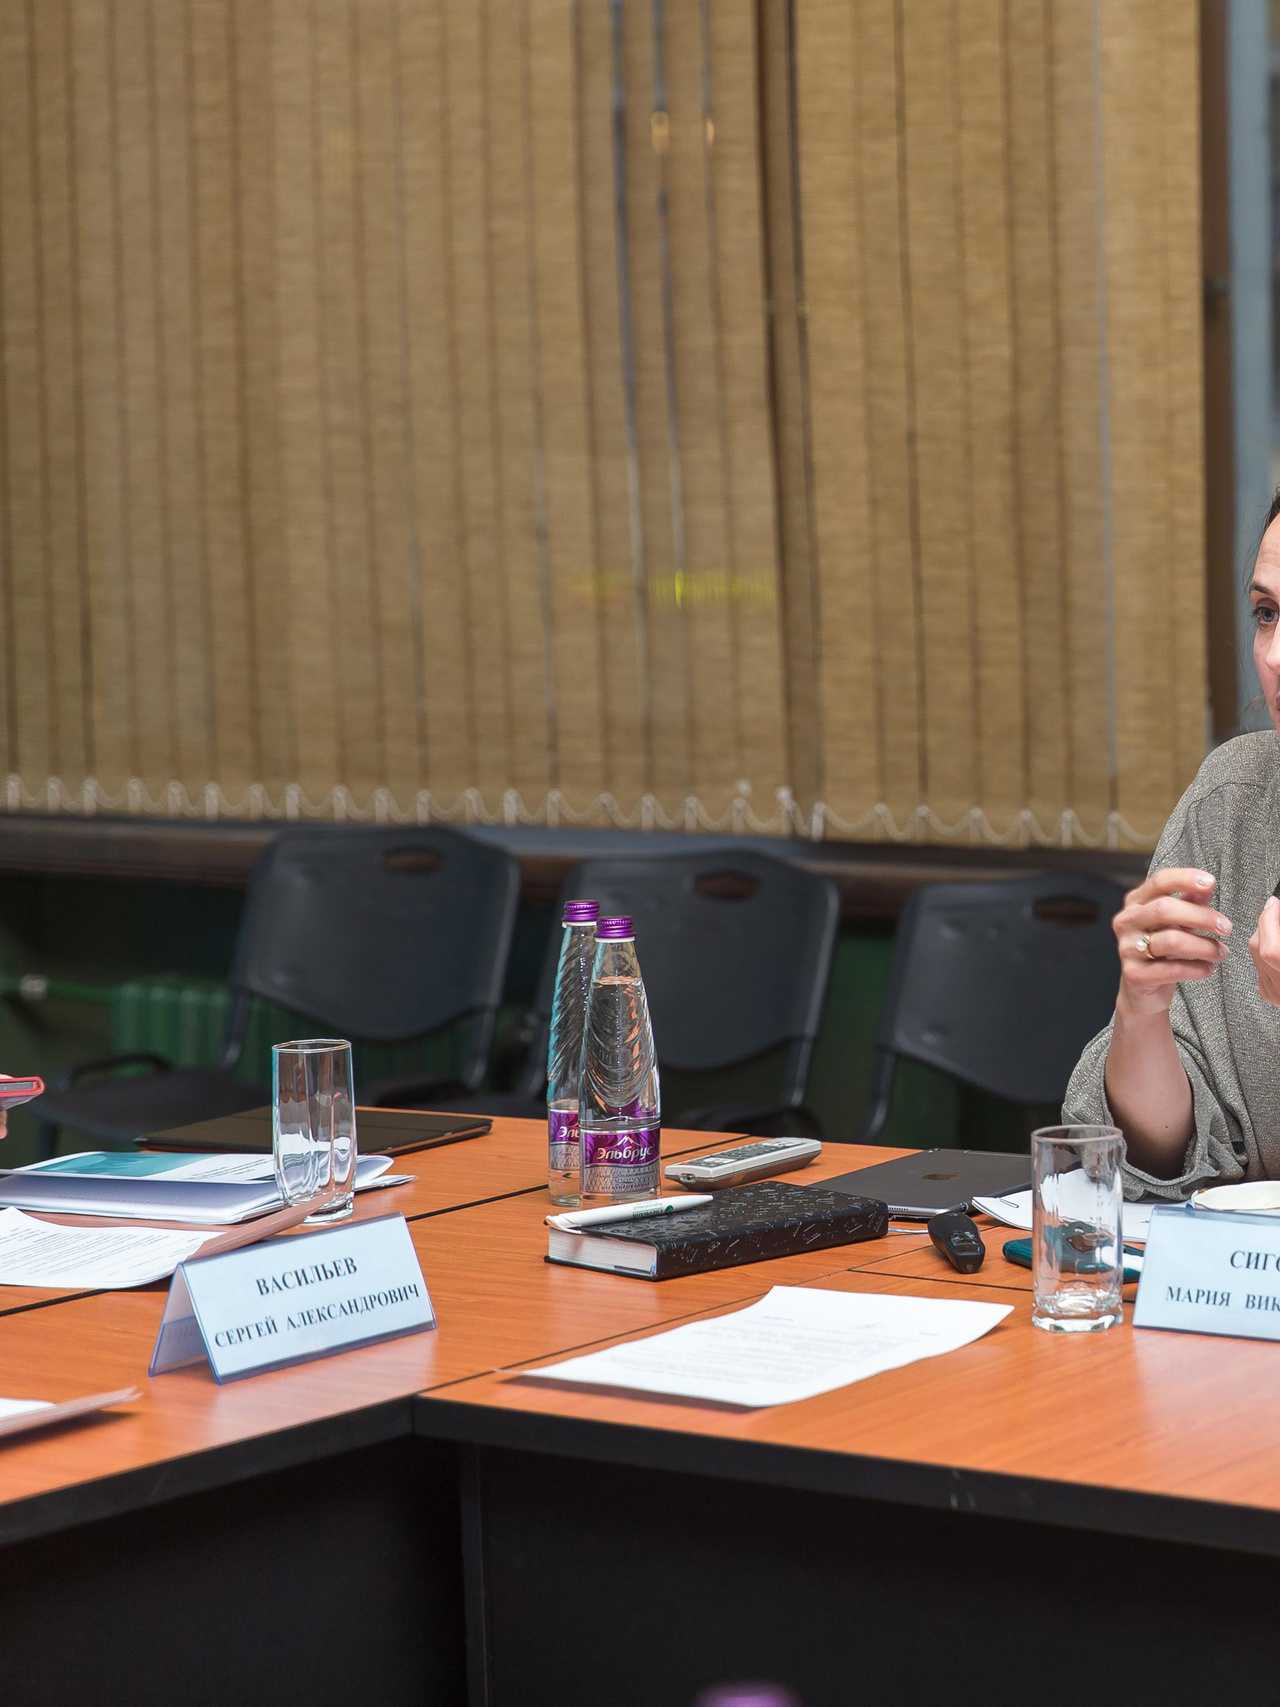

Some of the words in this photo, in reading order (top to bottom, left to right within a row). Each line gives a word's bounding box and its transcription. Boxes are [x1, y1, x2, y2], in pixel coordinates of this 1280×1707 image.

[596, 1145, 654, 1162] Эльбрус
[255, 1257, 358, 1296] ВАСИЛЬЕВ
[1165, 1286, 1232, 1307] МАРИЯ
[214, 1315, 279, 1348] СЕРГЕЙ
[286, 1283, 420, 1332] АЛЕКСАНДРОВИЧ
